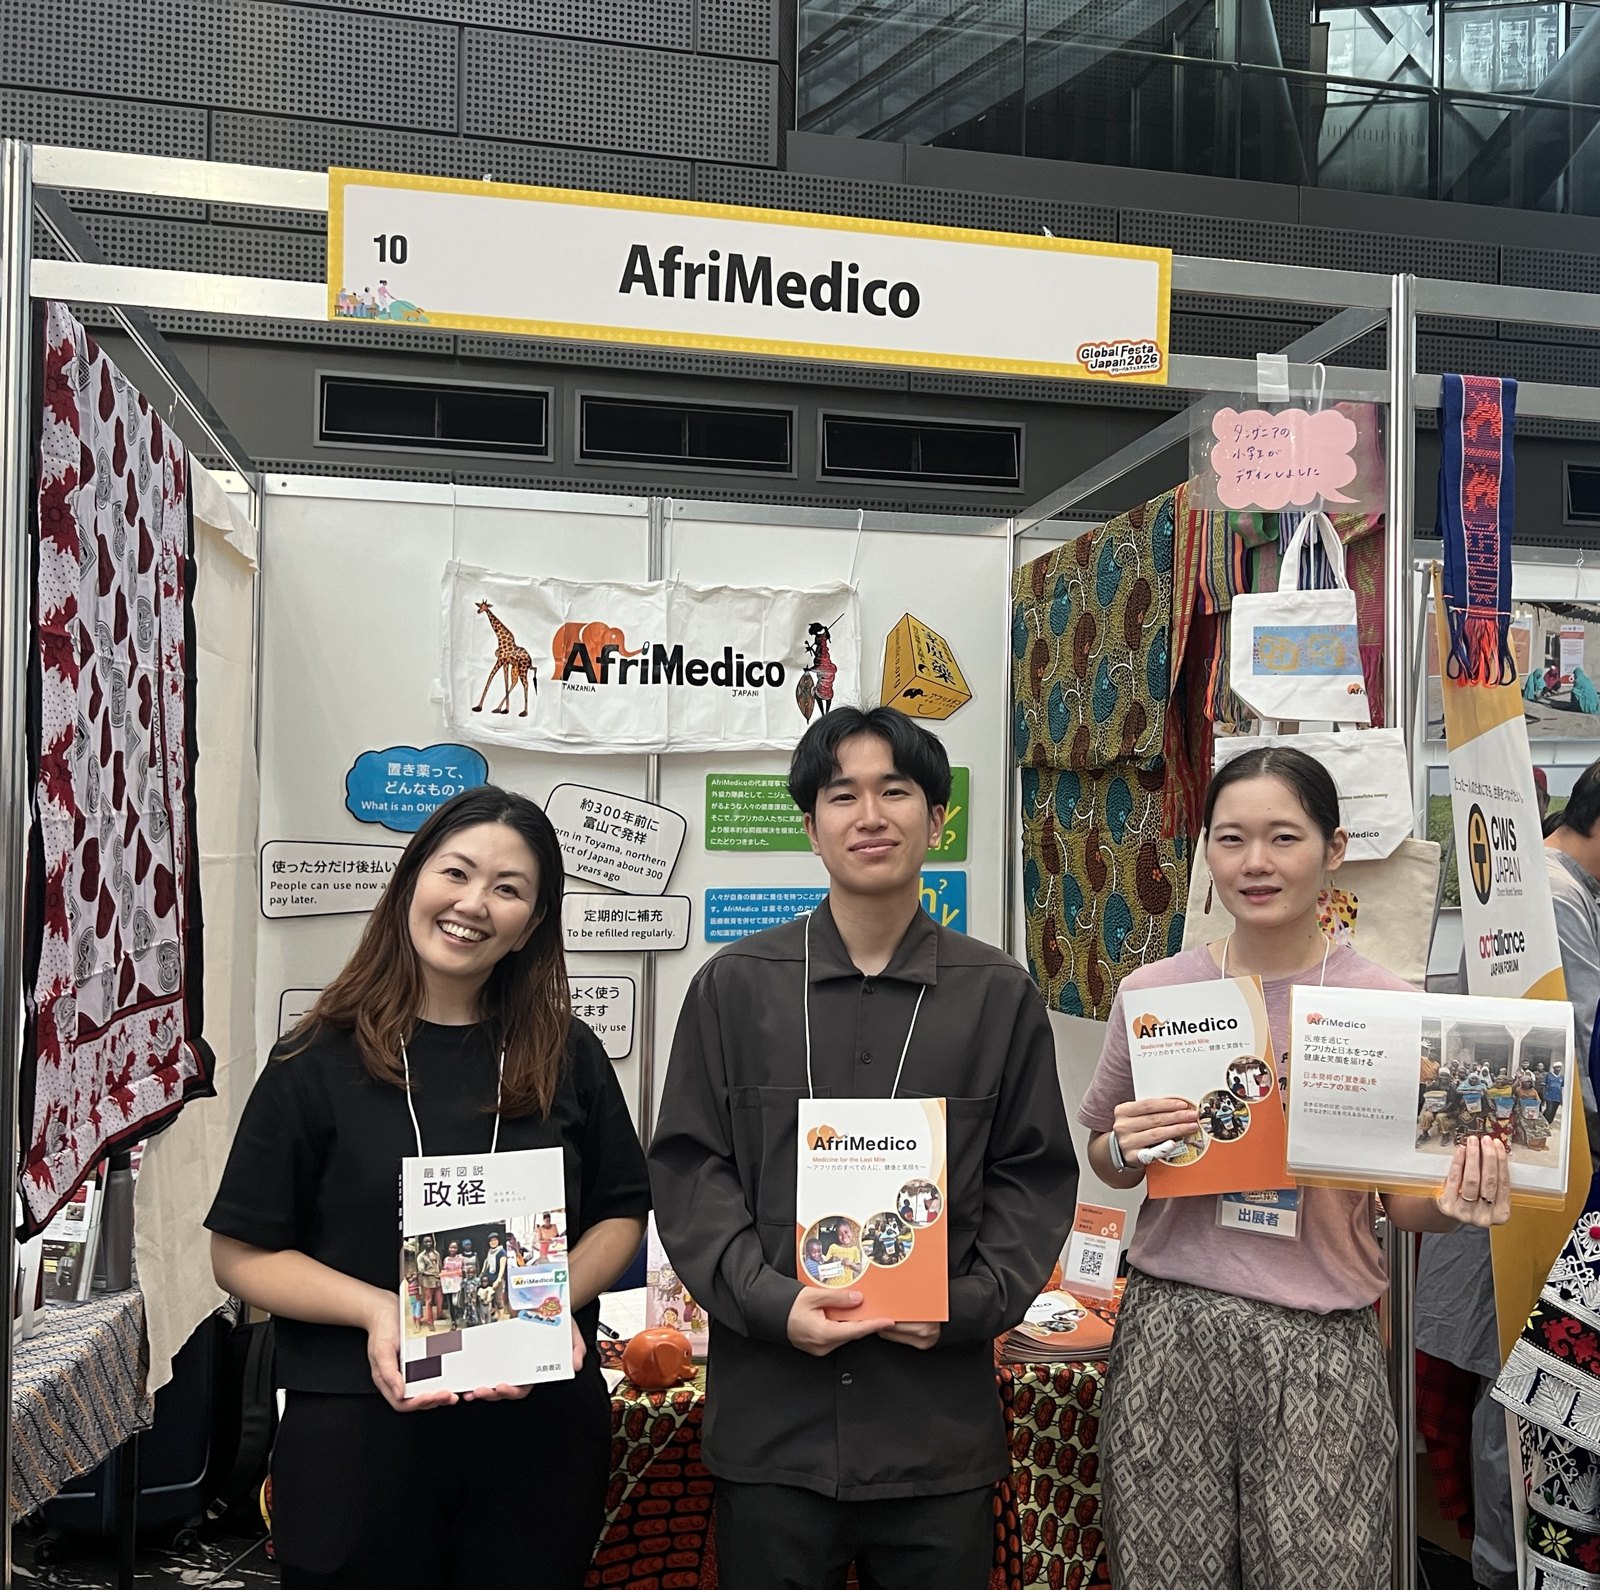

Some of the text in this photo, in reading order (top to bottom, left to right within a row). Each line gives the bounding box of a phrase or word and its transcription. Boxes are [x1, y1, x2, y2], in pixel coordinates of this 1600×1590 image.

[373, 234, 408, 265] 10
[619, 243, 921, 319] AfriMedico
[1081, 344, 1154, 359] Global Festa
[1090, 353, 1158, 369] Japan 2026
[1232, 445, 1282, 461] 小学生が
[1235, 468, 1320, 483] デザインしました
[562, 642, 785, 687] AfriMedico
[562, 683, 596, 693] TANZANIA
[731, 689, 759, 697] JAPANI
[388, 763, 463, 779] 置き薬って、
[361, 801, 388, 811] What
[391, 801, 399, 811] is
[401, 803, 413, 812] an
[580, 798, 660, 832] 約300年前に
[583, 816, 648, 845] 富山で発祥
[1491, 815, 1518, 852] CWS
[554, 827, 667, 867] orn in Toyama, northern
[272, 860, 397, 874] 使った分だけ後払い
[559, 843, 663, 880] rict of Japan about 300
[576, 863, 620, 881] years ago
[1494, 856, 1523, 883] JAPAN
[270, 881, 307, 892] People
[311, 882, 329, 890] can
[333, 882, 352, 890] use
[355, 882, 378, 890] now
[270, 895, 317, 906] pay later.
[584, 909, 663, 922] 定期的に補充
[567, 928, 675, 939] To be refilled regularly.
[1490, 959, 1519, 977] JAPAN FORUM
[571, 987, 620, 999] よく使う
[571, 1004, 608, 1017] てます
[590, 1023, 607, 1033] aily
[1139, 1016, 1238, 1039] AfriMedico
[1309, 1018, 1366, 1029] AfriMedico
[1304, 1034, 1350, 1045] 医療を通じて
[1304, 1044, 1388, 1059] アフリカと日本をつなぎ、
[813, 1136, 917, 1151] AfriMedico
[423, 1165, 484, 1179] 最新図説
[423, 1180, 486, 1207] 政経
[1238, 1208, 1279, 1227] 出展者
[515, 1277, 554, 1285] AfriMedico
